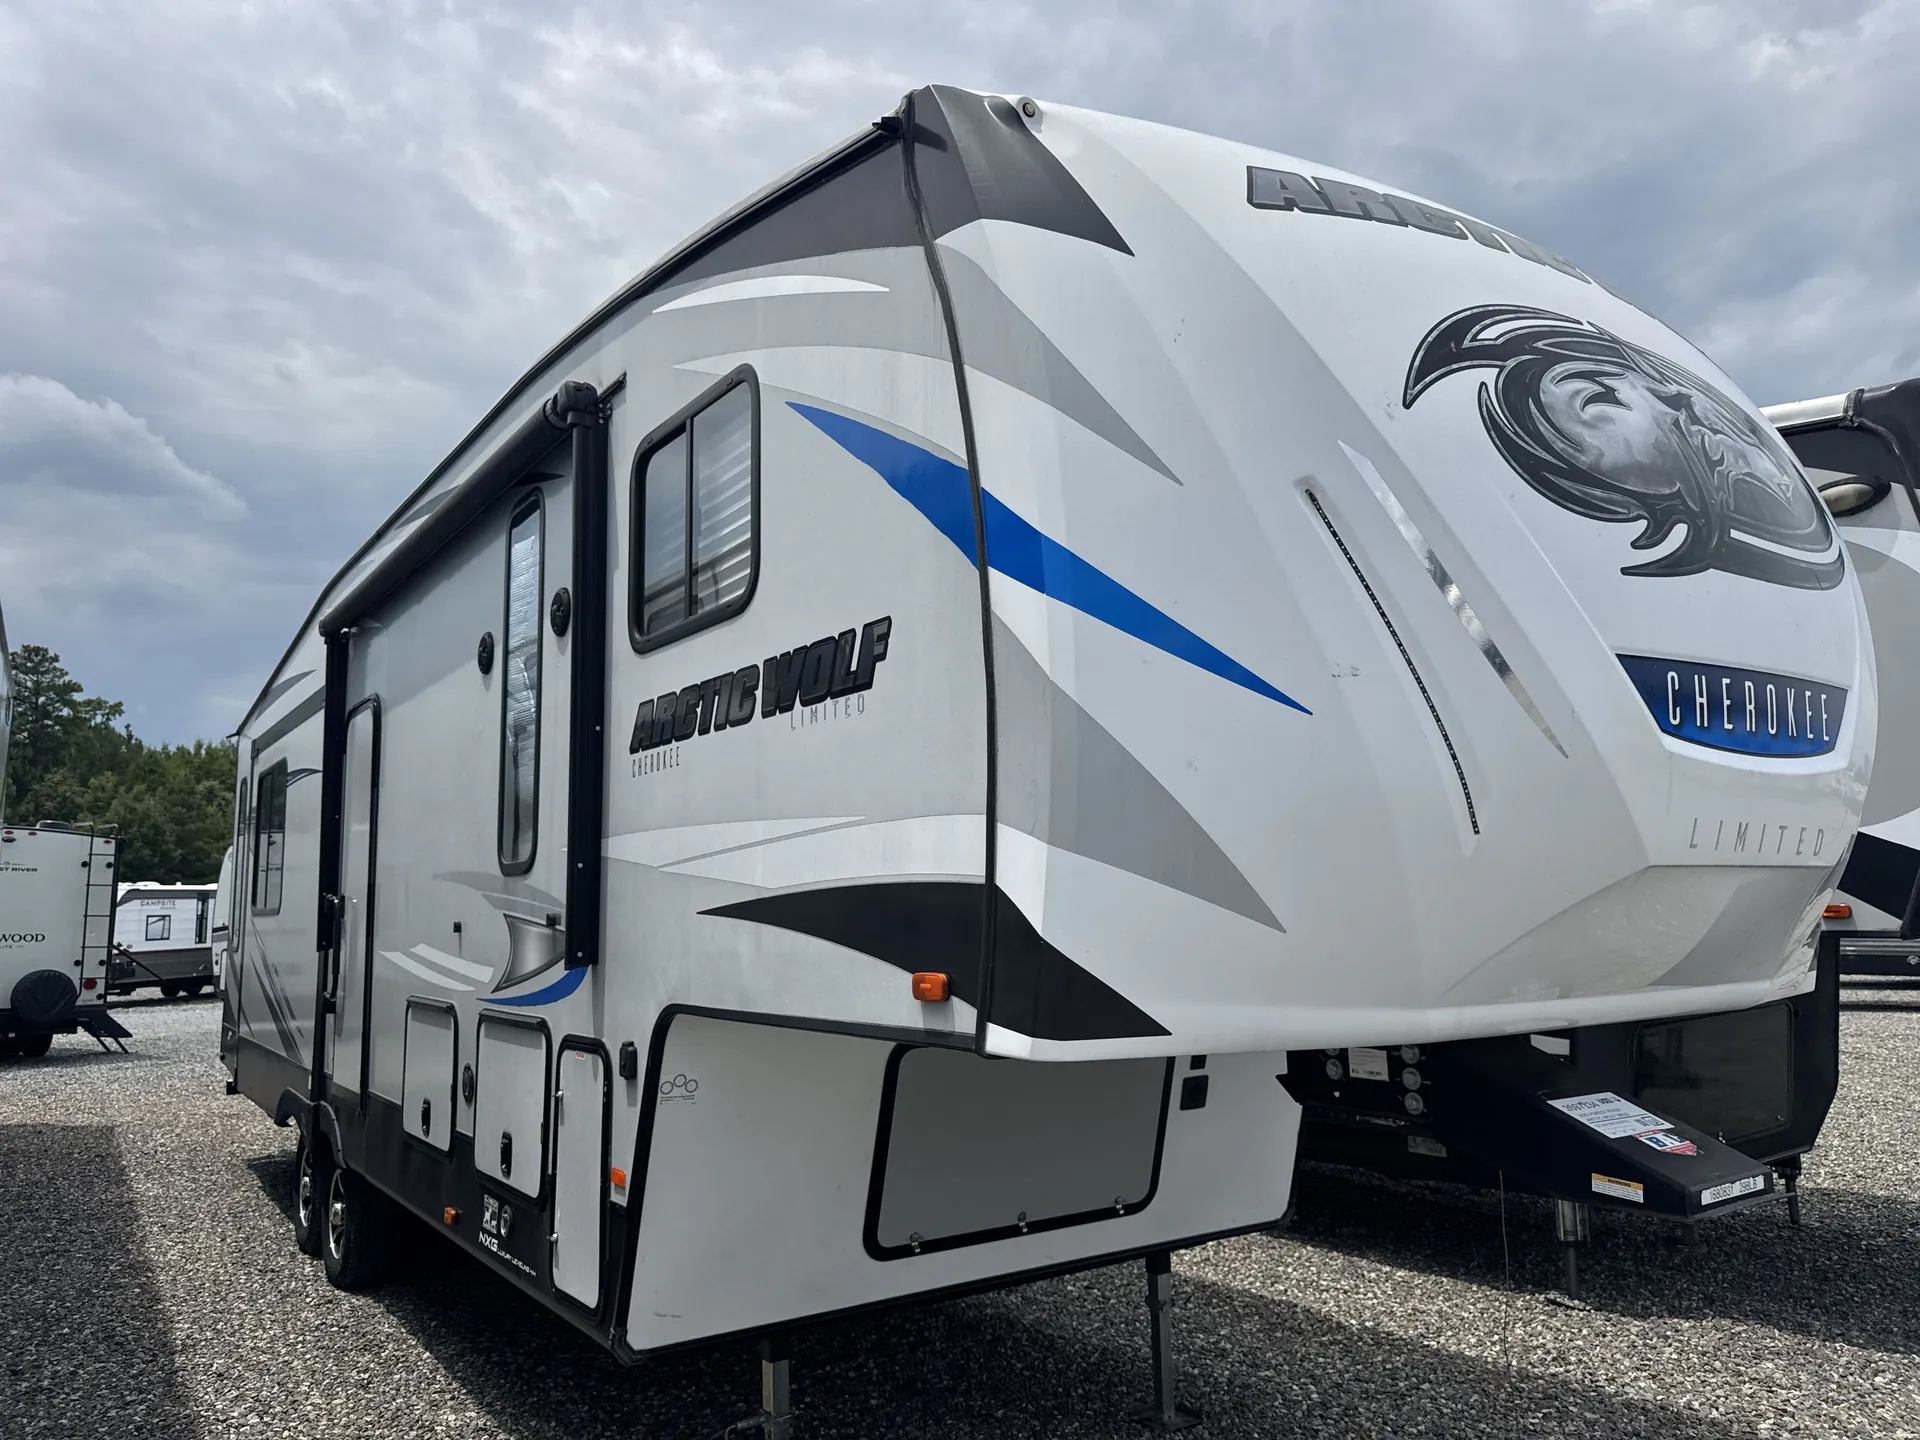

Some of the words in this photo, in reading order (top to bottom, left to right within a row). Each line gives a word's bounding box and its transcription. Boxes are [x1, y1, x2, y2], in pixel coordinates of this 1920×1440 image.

[629, 663, 760, 755] ARCTIC
[761, 615, 892, 719] WOLF
[790, 693, 865, 731] LIMITED
[1667, 671, 1830, 742] CHEROKEE
[632, 746, 680, 778] CHEROKEE
[1689, 817, 1824, 857] LIMITED
[479, 1231, 498, 1252] NXG
